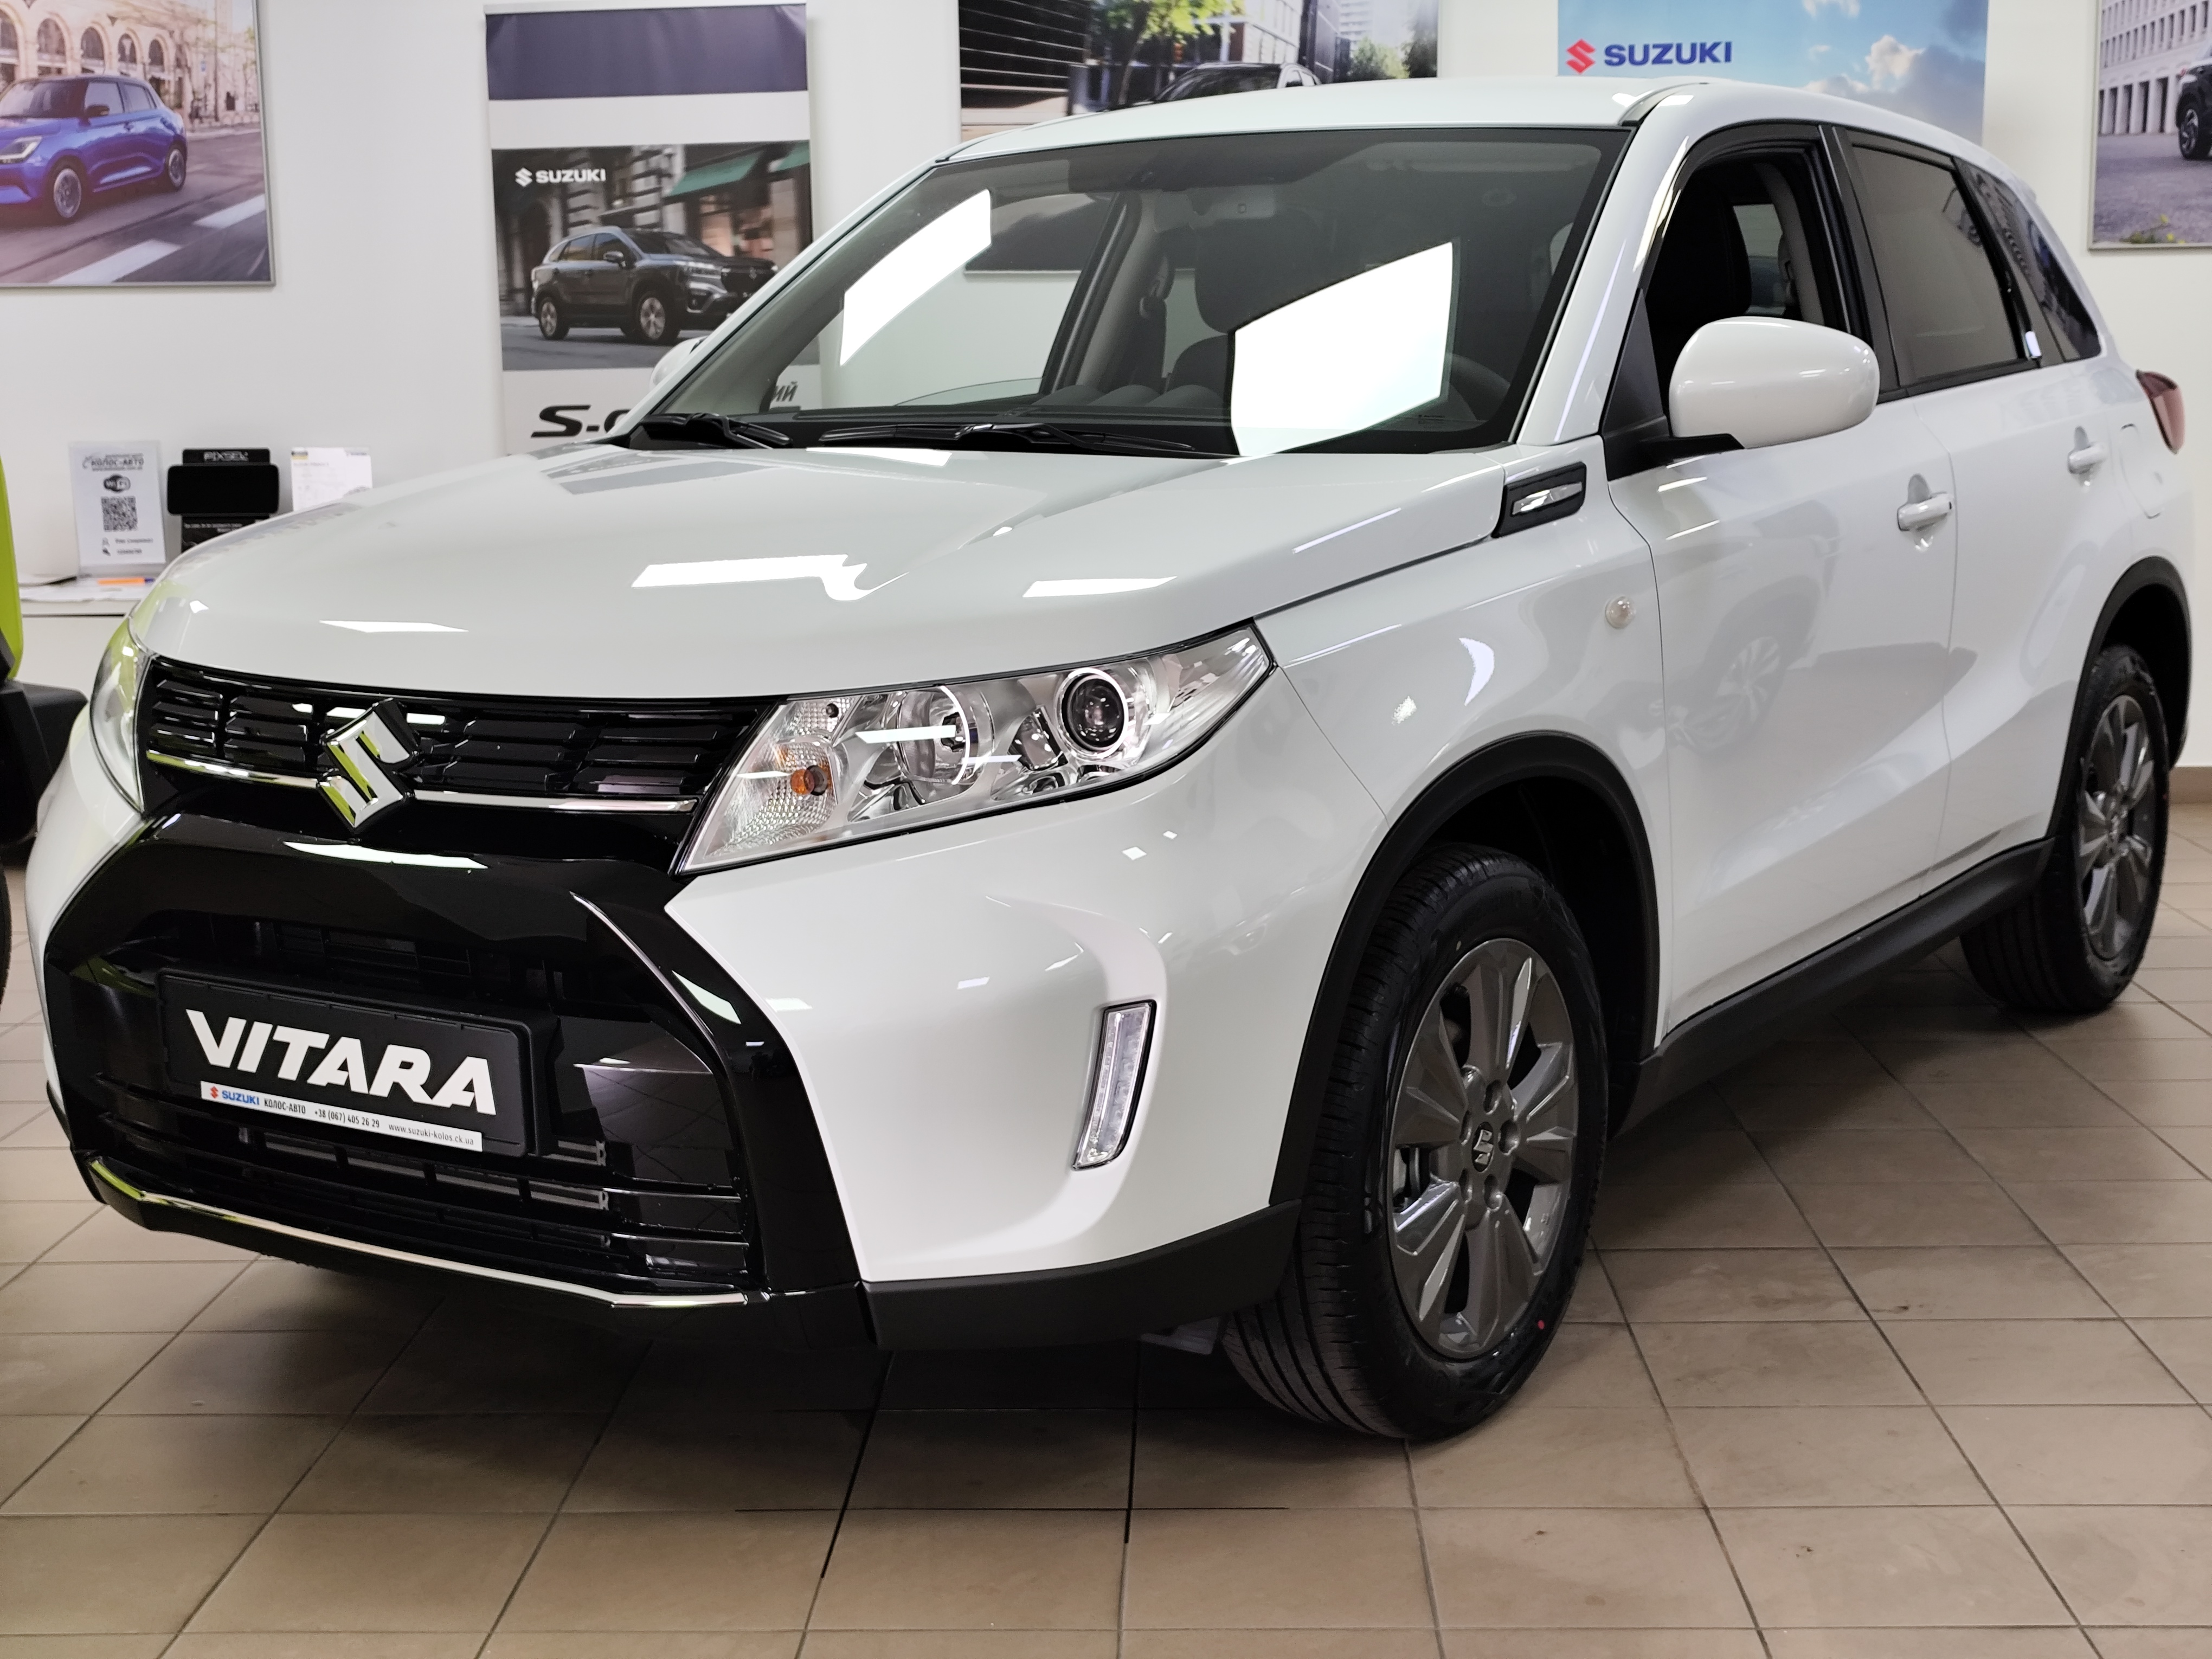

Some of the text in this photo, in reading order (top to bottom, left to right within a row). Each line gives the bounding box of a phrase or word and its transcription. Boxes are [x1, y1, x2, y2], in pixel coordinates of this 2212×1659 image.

[1604, 41, 1732, 66] SUZUKI
[536, 168, 606, 183] SUZUKI
[186, 1009, 496, 1115] VITARA
[222, 1090, 474, 1146] SUZUKI КОЛОС-АВТО +38 (067) 405 26 29 www.suzuki-kolos.ck.ua
